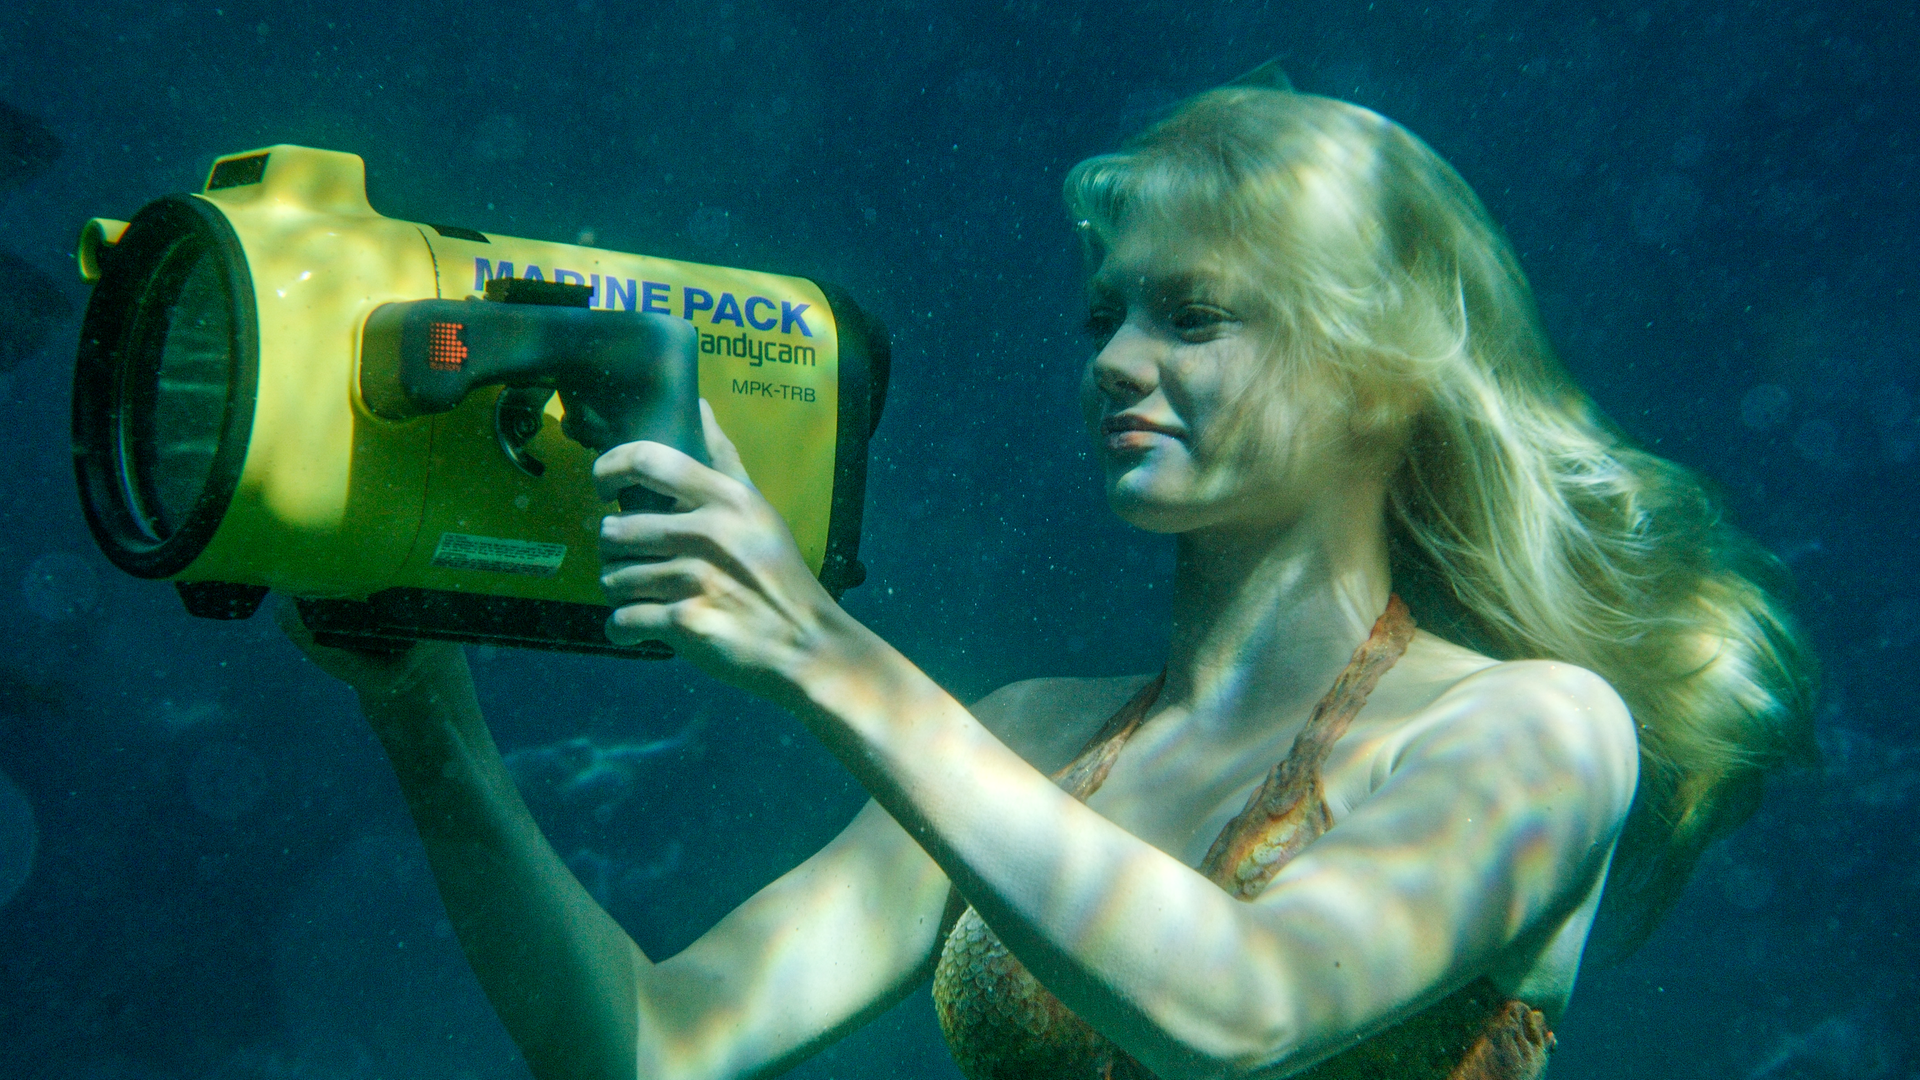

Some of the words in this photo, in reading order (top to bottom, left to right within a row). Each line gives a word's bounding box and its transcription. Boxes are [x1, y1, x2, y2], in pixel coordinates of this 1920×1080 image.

[683, 287, 813, 337] PACK
[695, 327, 816, 367] andycam
[732, 379, 816, 402] MPK-TRB
